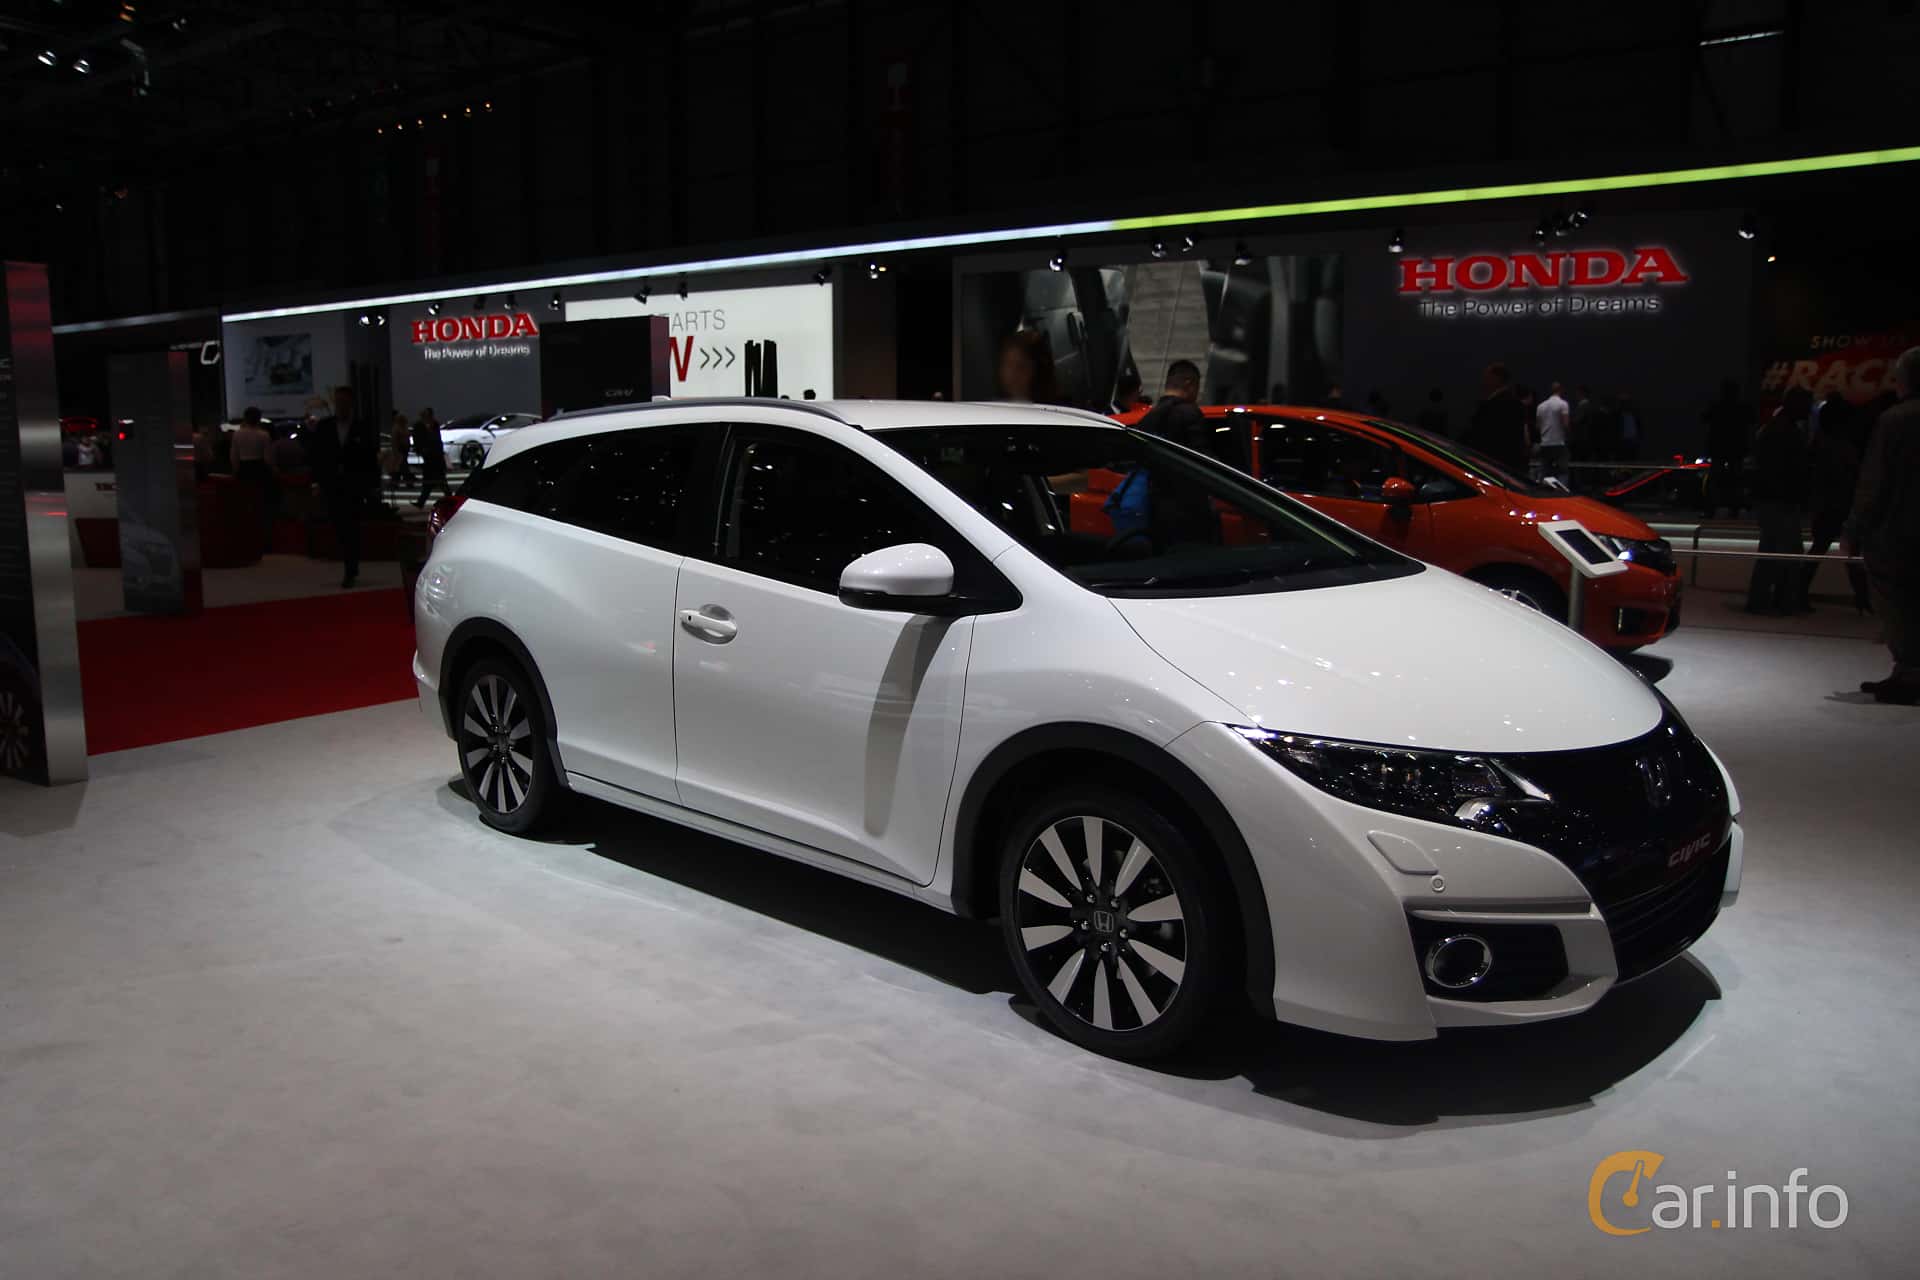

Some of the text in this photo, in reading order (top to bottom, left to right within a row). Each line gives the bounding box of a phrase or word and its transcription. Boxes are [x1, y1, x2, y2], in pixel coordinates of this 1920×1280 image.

[1397, 248, 1690, 292] HONDA
[1419, 294, 1661, 319] The Power of Dreams
[410, 312, 539, 344] HONDA
[424, 344, 531, 360] The Power of Dreams
[1668, 832, 1712, 867] CIVIC
